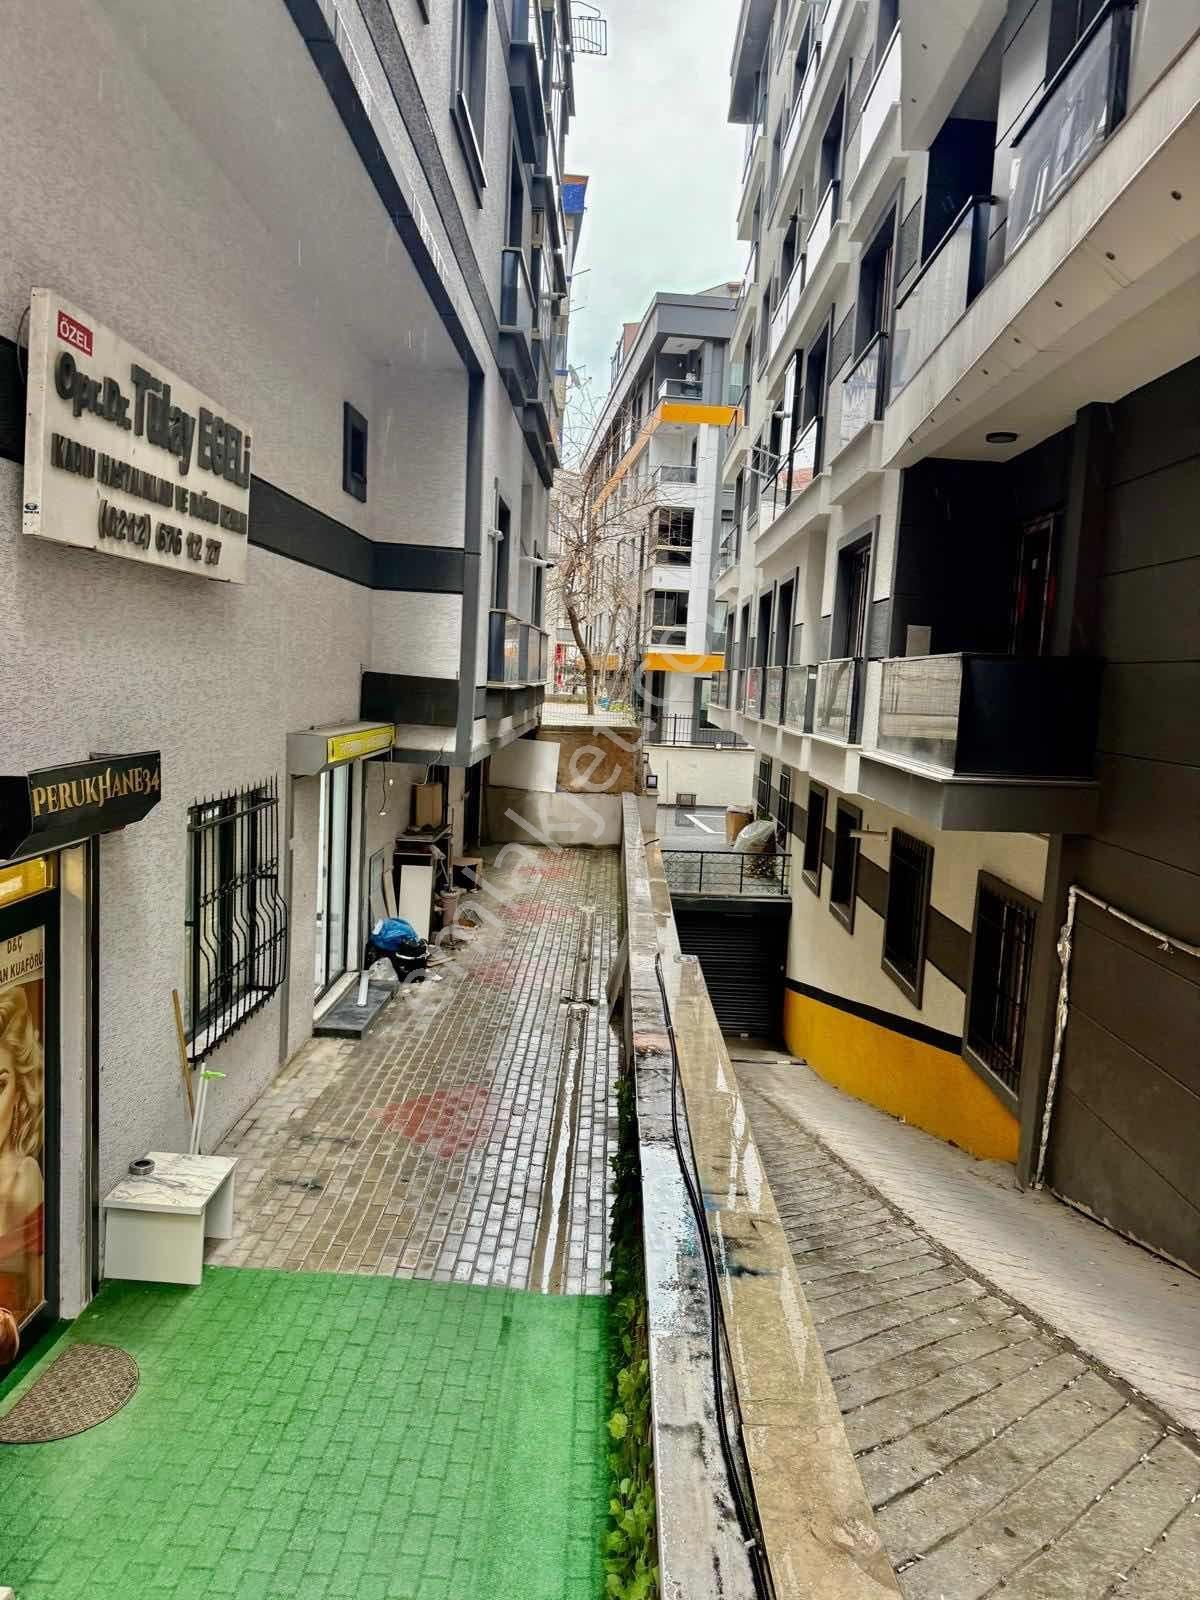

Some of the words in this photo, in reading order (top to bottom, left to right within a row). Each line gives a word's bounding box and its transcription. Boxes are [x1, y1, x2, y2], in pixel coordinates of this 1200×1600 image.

[60, 317, 92, 353] ÖZEL
[98, 499, 151, 550] (0212)
[155, 521, 183, 556] 676
[32, 767, 160, 817] PERUKHANE34
